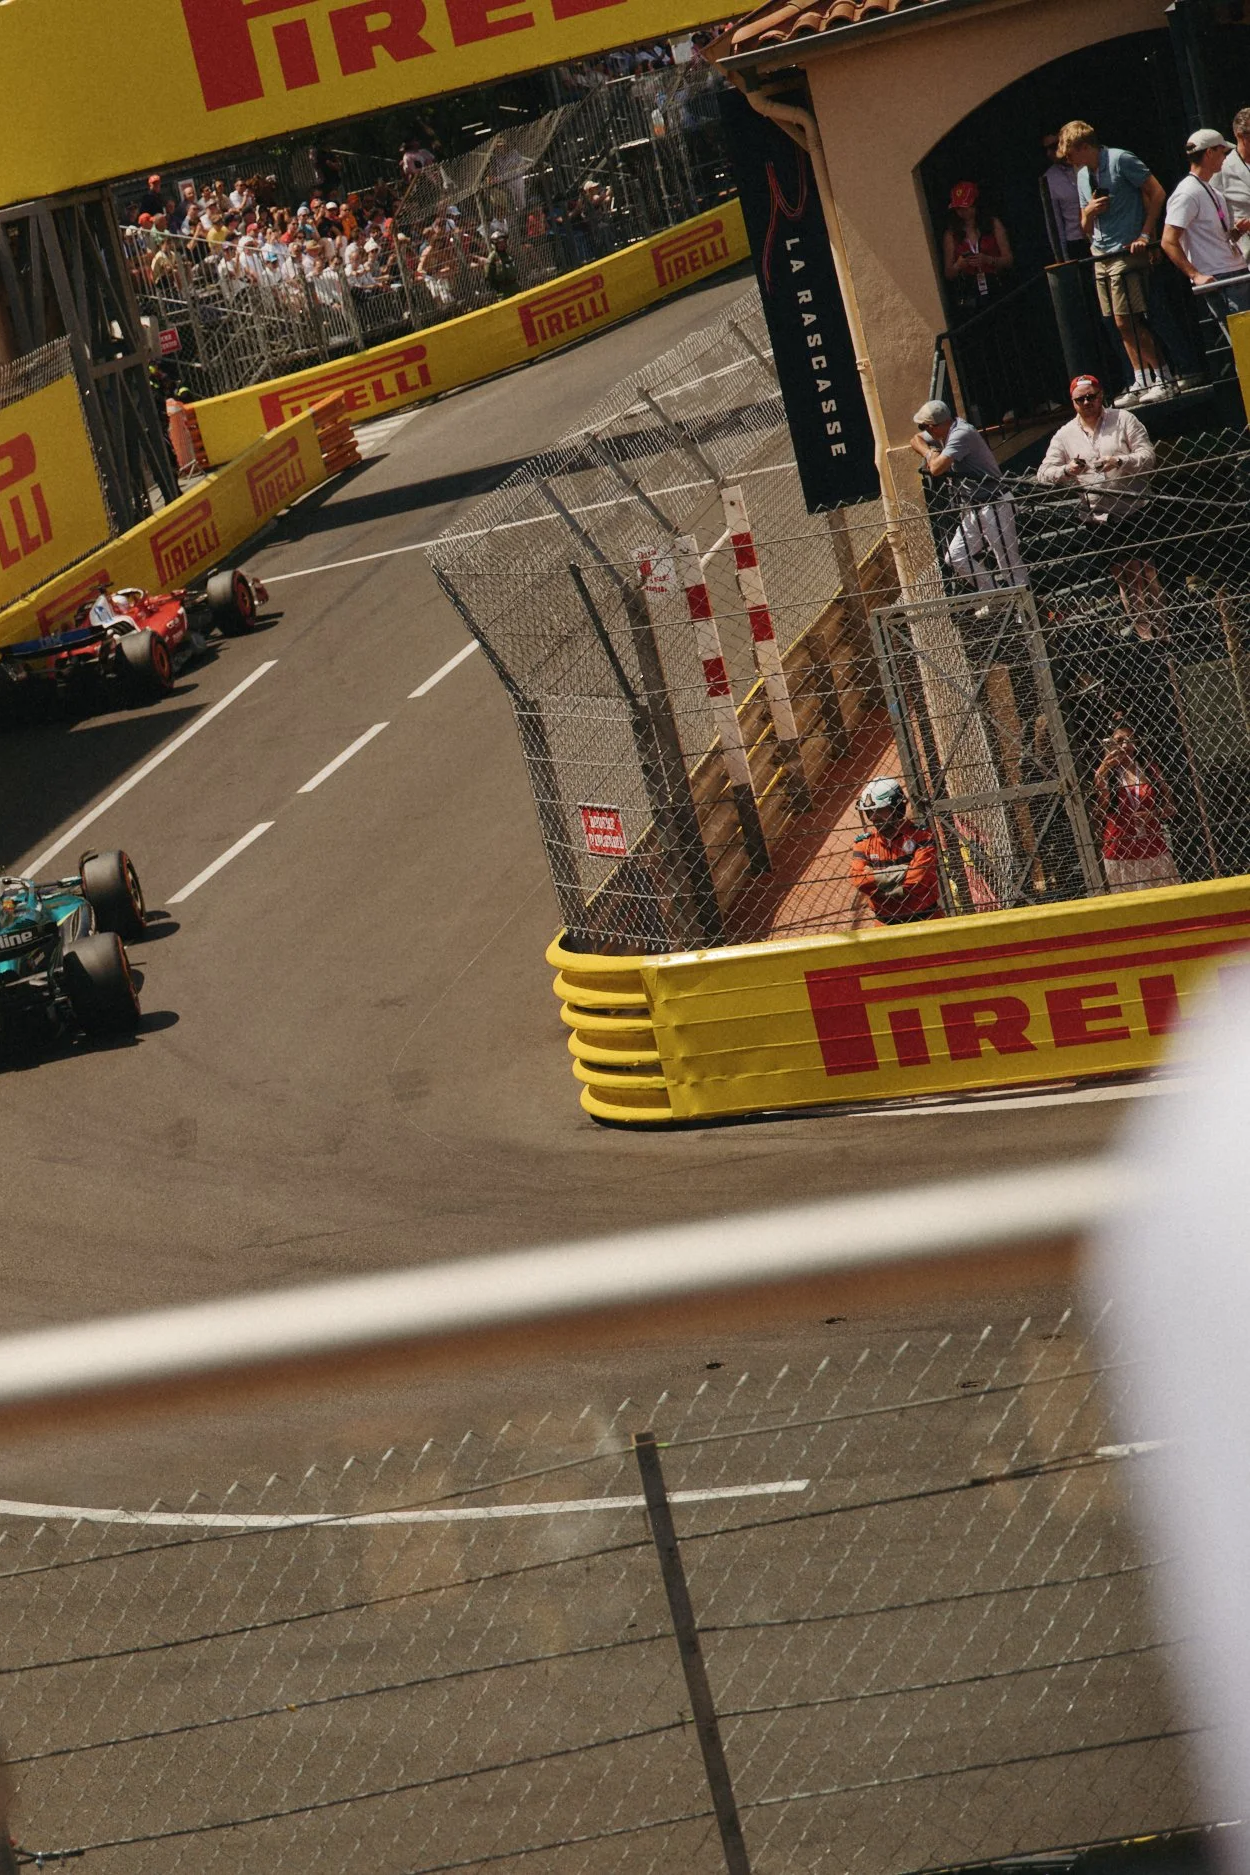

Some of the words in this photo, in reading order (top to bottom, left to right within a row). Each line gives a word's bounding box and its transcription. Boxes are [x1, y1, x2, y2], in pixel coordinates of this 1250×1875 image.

[652, 219, 729, 287] PIRELLI
[517, 273, 610, 347] PIRELLI
[786, 238, 806, 272] LA
[797, 289, 847, 457] RASCASSE
[259, 344, 431, 432] PELLI
[246, 437, 306, 517] PIRELLI
[150, 498, 220, 587] PIRELLI
